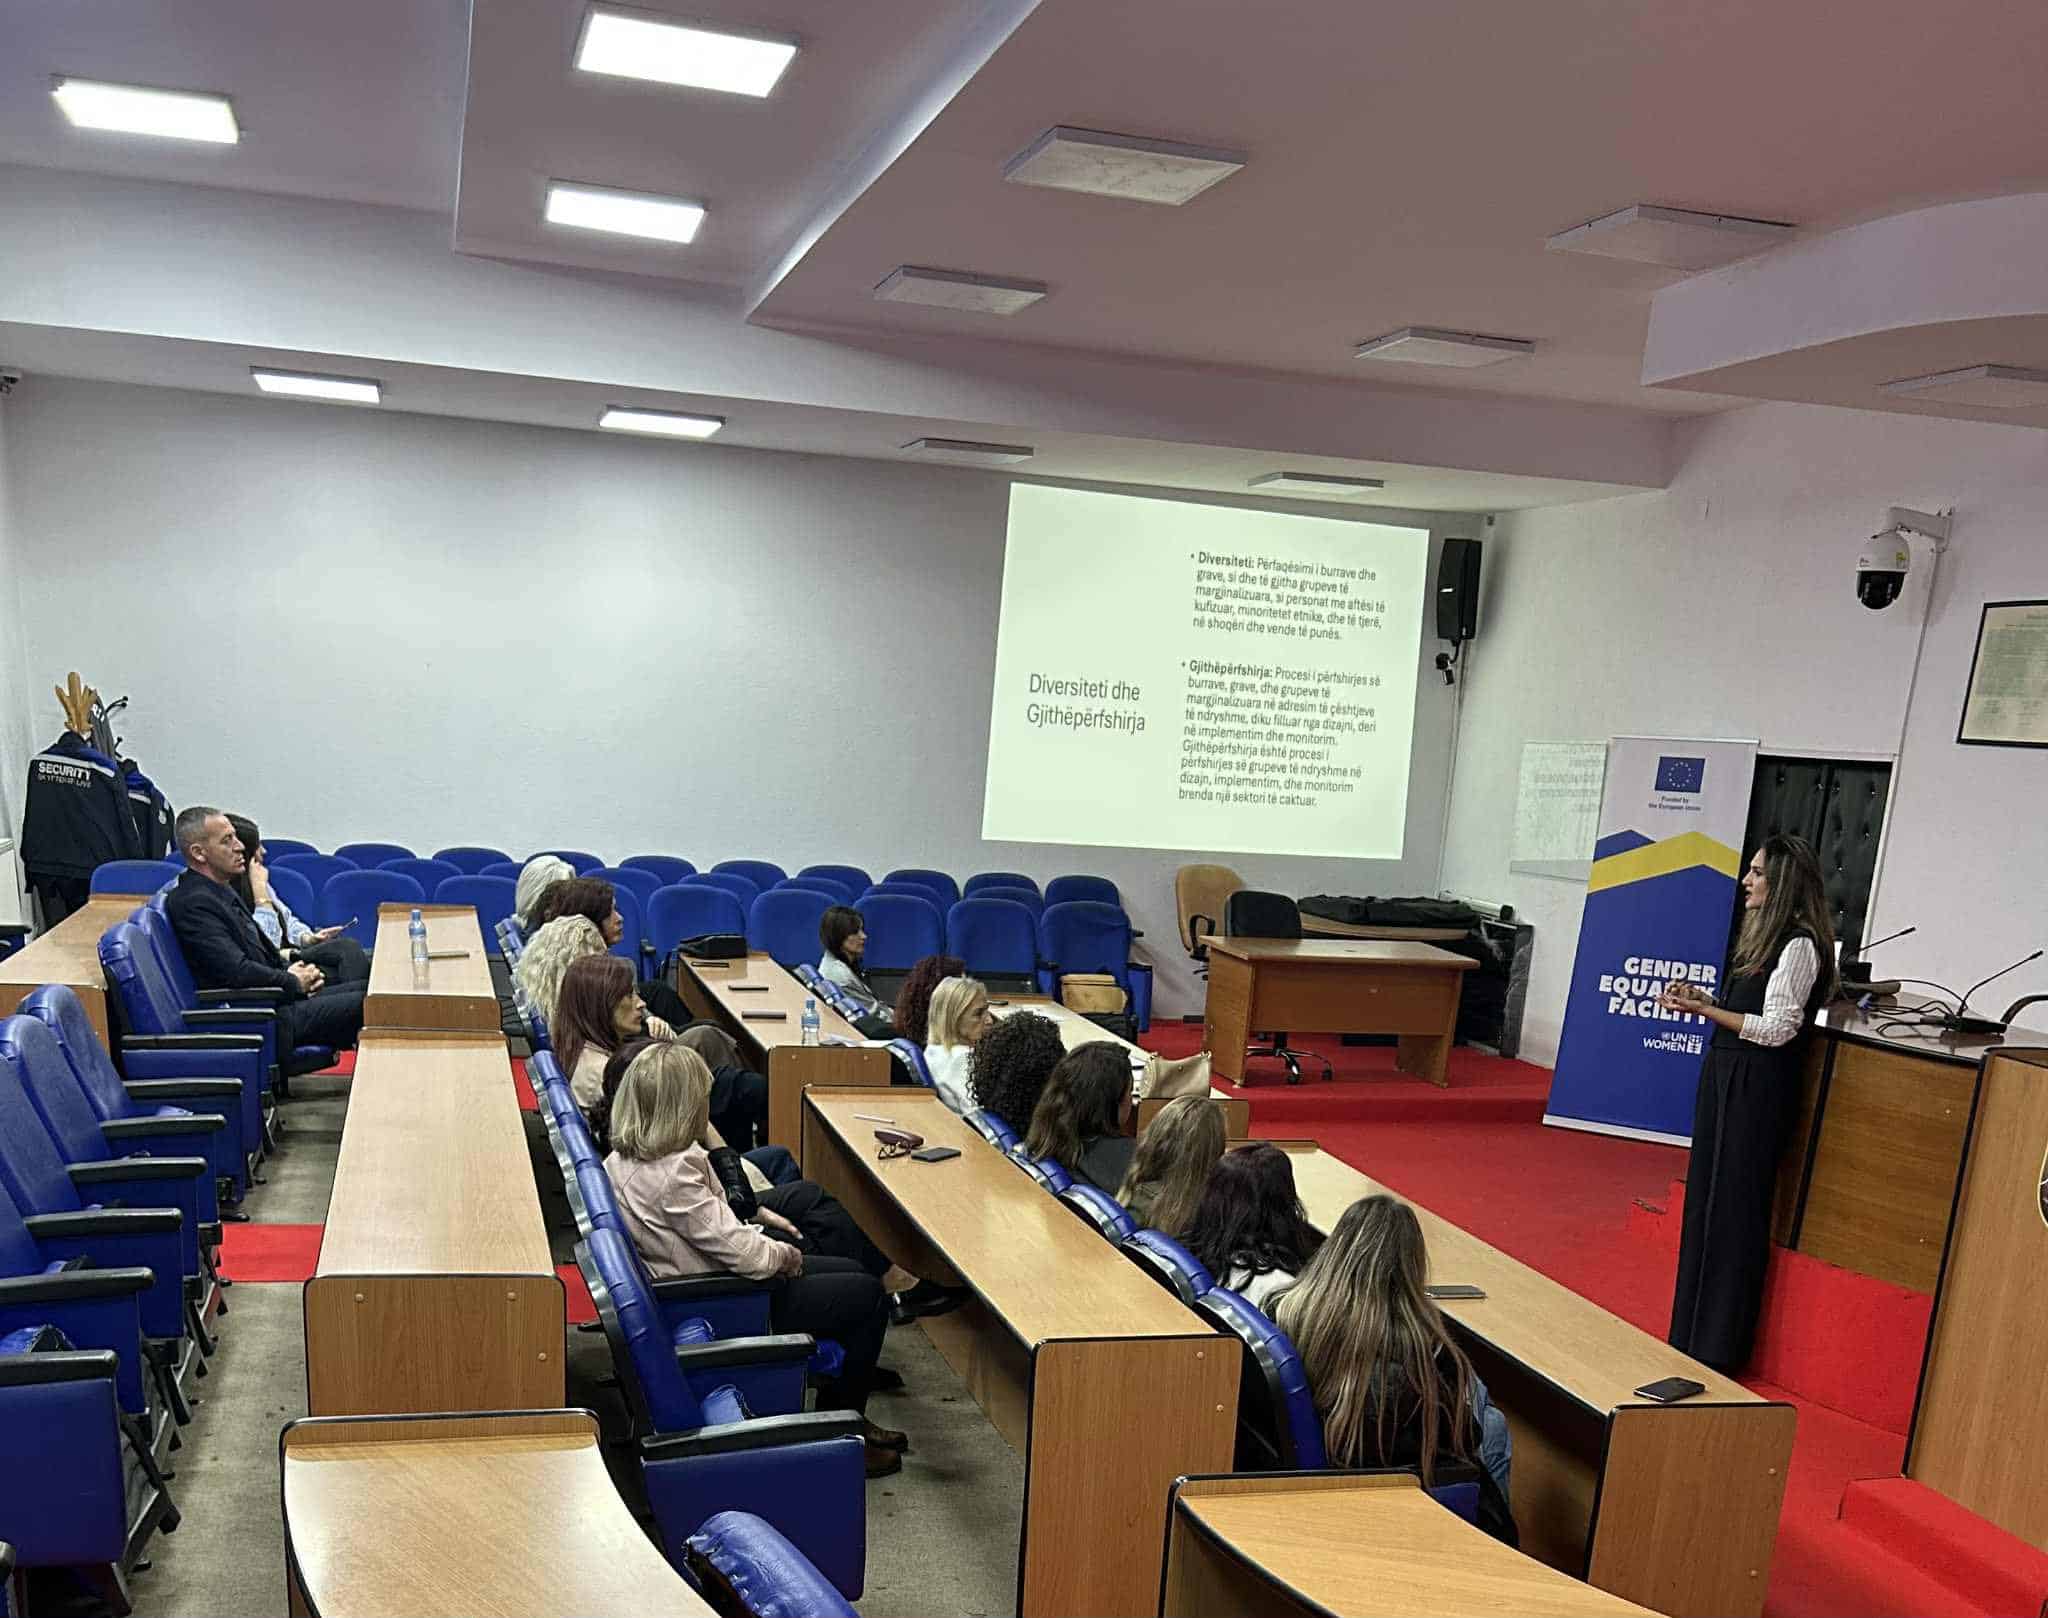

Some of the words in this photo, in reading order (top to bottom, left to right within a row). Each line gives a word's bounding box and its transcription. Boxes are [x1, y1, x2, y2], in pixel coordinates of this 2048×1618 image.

[1199, 552, 1254, 568] Diversiteti:
[1190, 660, 1272, 680] Gjithëpërfshirja:
[1029, 673, 1108, 699] Diversiteti
[1027, 703, 1145, 736] Gjithëpërfshirja
[1183, 740, 1257, 757] Gjithëpërfshirja
[39, 761, 89, 780] SECURITY
[1624, 957, 1717, 983] GENDER
[1643, 1038, 1685, 1052] WOMEN
[1671, 1032, 1687, 1042] UN
